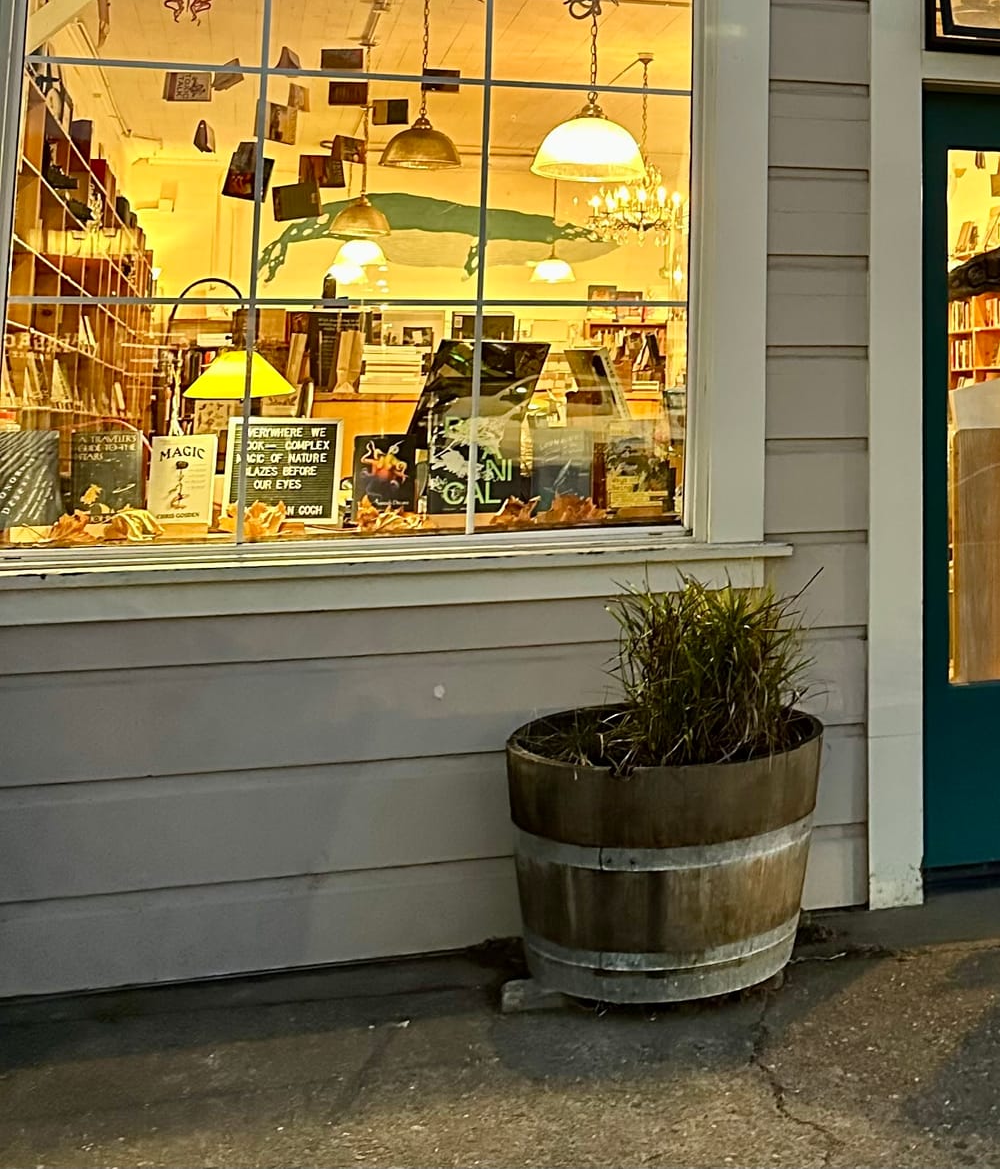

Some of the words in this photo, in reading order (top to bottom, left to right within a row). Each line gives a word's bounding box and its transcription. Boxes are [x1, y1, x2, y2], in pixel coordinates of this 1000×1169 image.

[247, 427, 303, 438] VERYWHERE
[311, 427, 327, 437] WE
[285, 440, 330, 450] COMPLEX
[159, 446, 206, 462] MAGIC
[270, 453, 283, 463] OF
[288, 452, 327, 463] NATURE
[282, 466, 317, 477] BEFORE
[253, 479, 272, 490] OUR
[276, 479, 302, 490] EYES
[442, 481, 502, 504] CAL
[298, 505, 323, 516] GOGH
